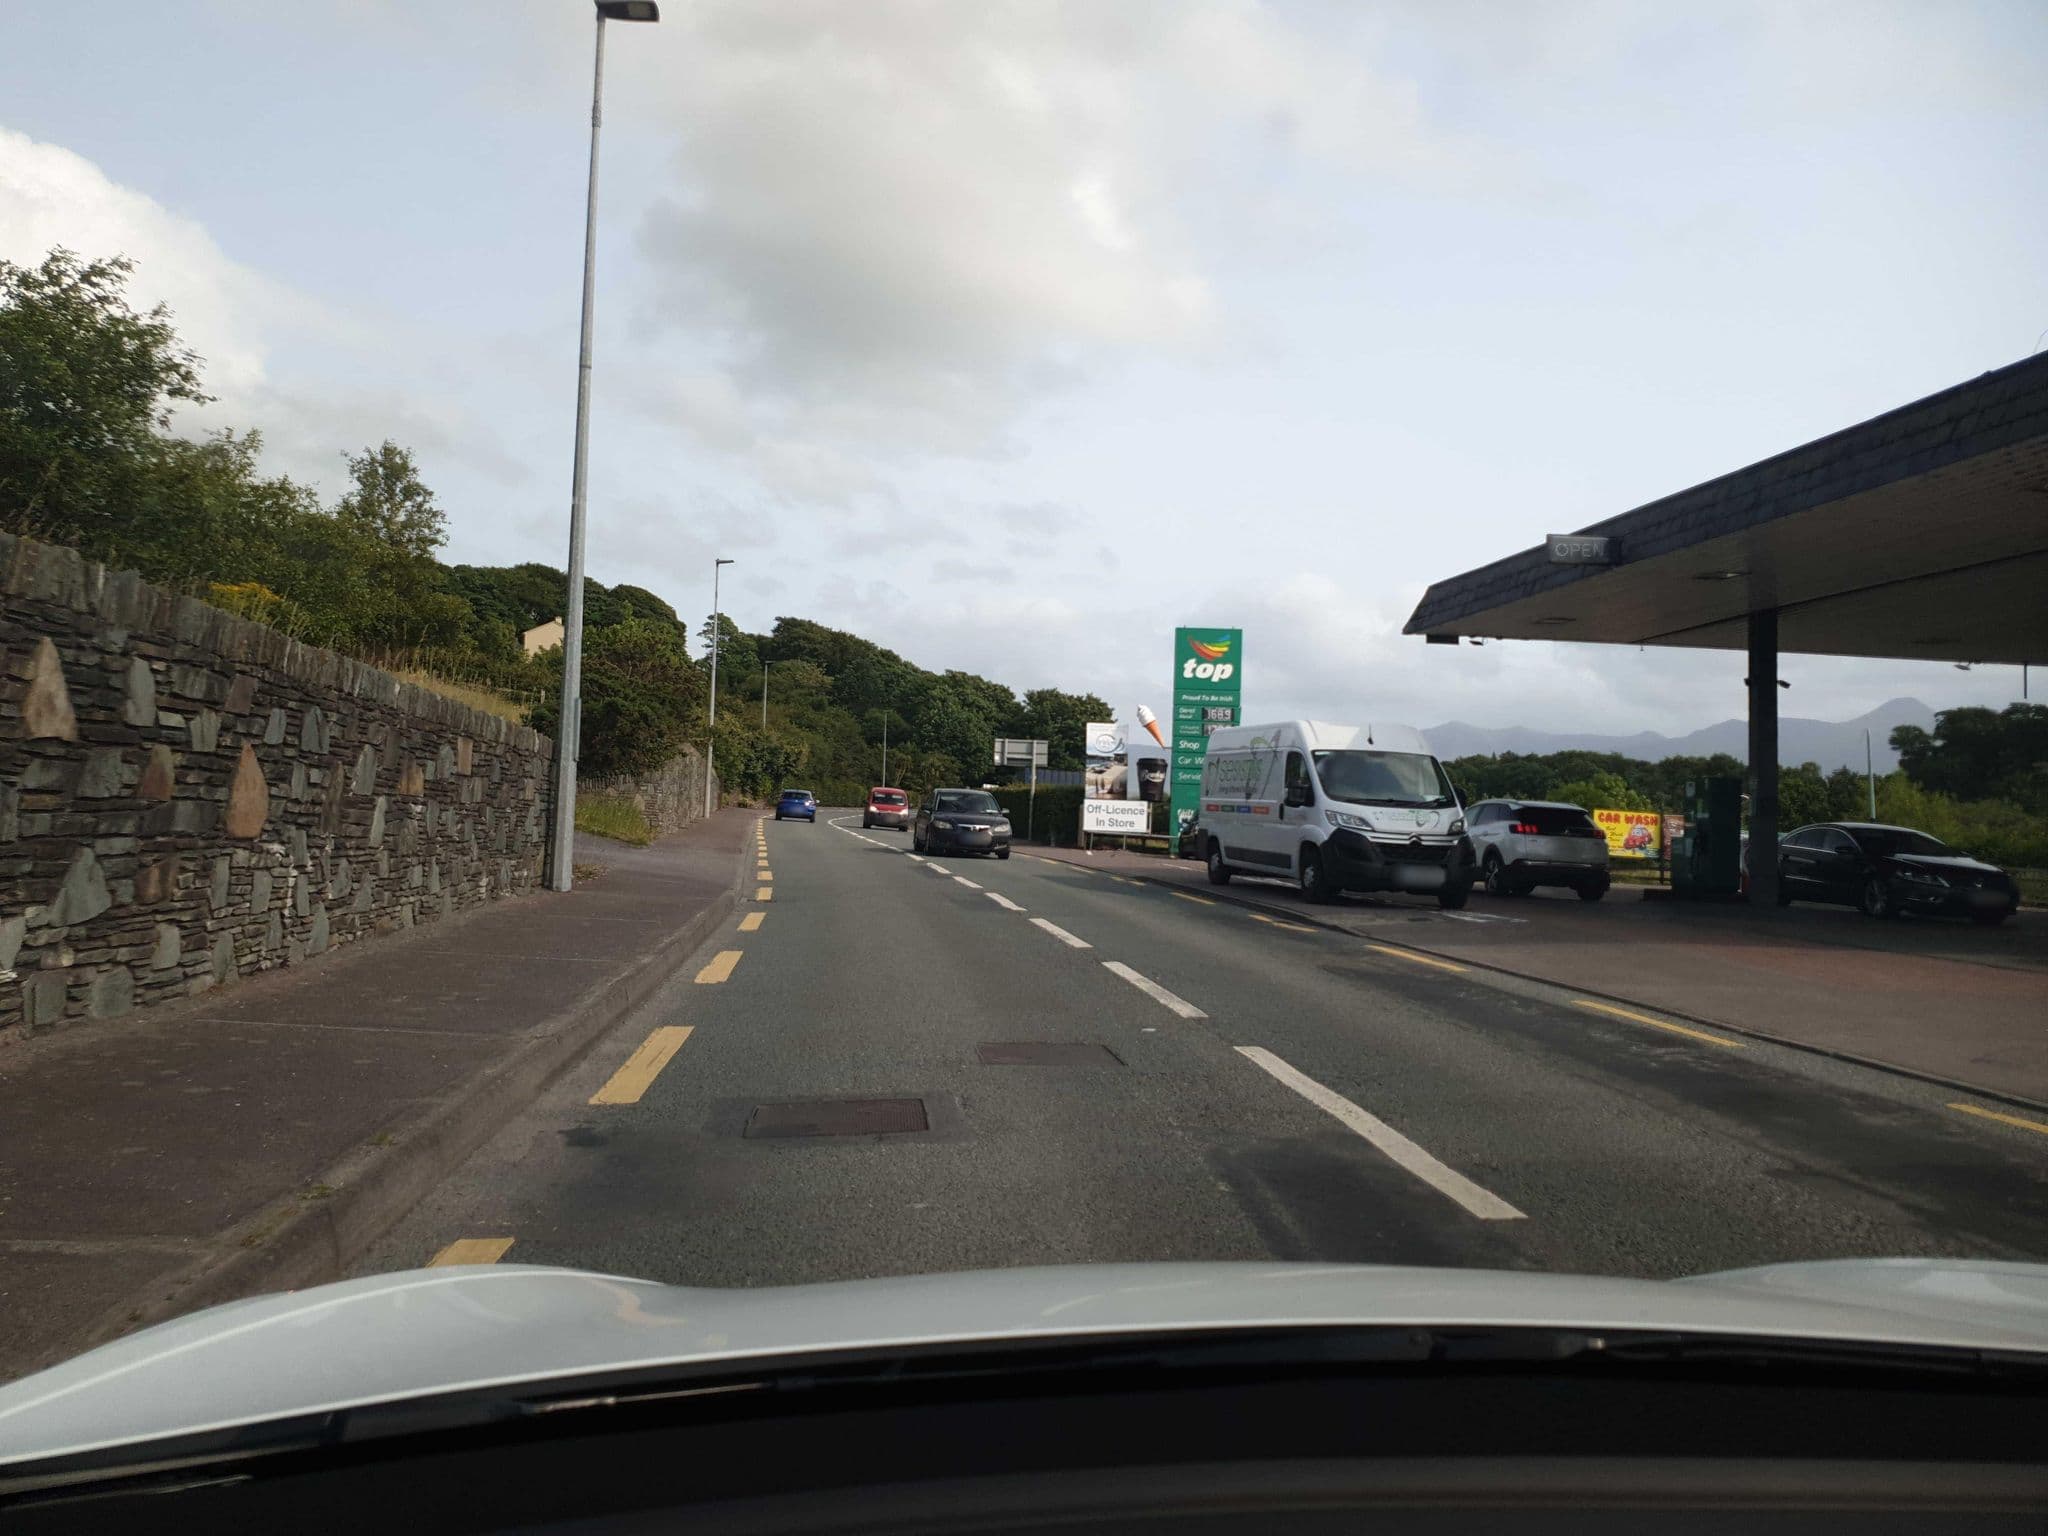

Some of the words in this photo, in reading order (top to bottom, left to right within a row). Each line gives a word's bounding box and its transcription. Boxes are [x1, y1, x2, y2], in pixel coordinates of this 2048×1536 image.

[1555, 543, 1604, 557] OPEN
[1183, 658, 1233, 682] top
[1179, 740, 1200, 750] Shop
[1178, 756, 1192, 765] Car
[1087, 804, 1145, 816] Off-Licence
[1096, 817, 1105, 826] In
[1108, 817, 1135, 828] Store
[1598, 812, 1621, 824] CAR
[1625, 814, 1658, 826] WASH
